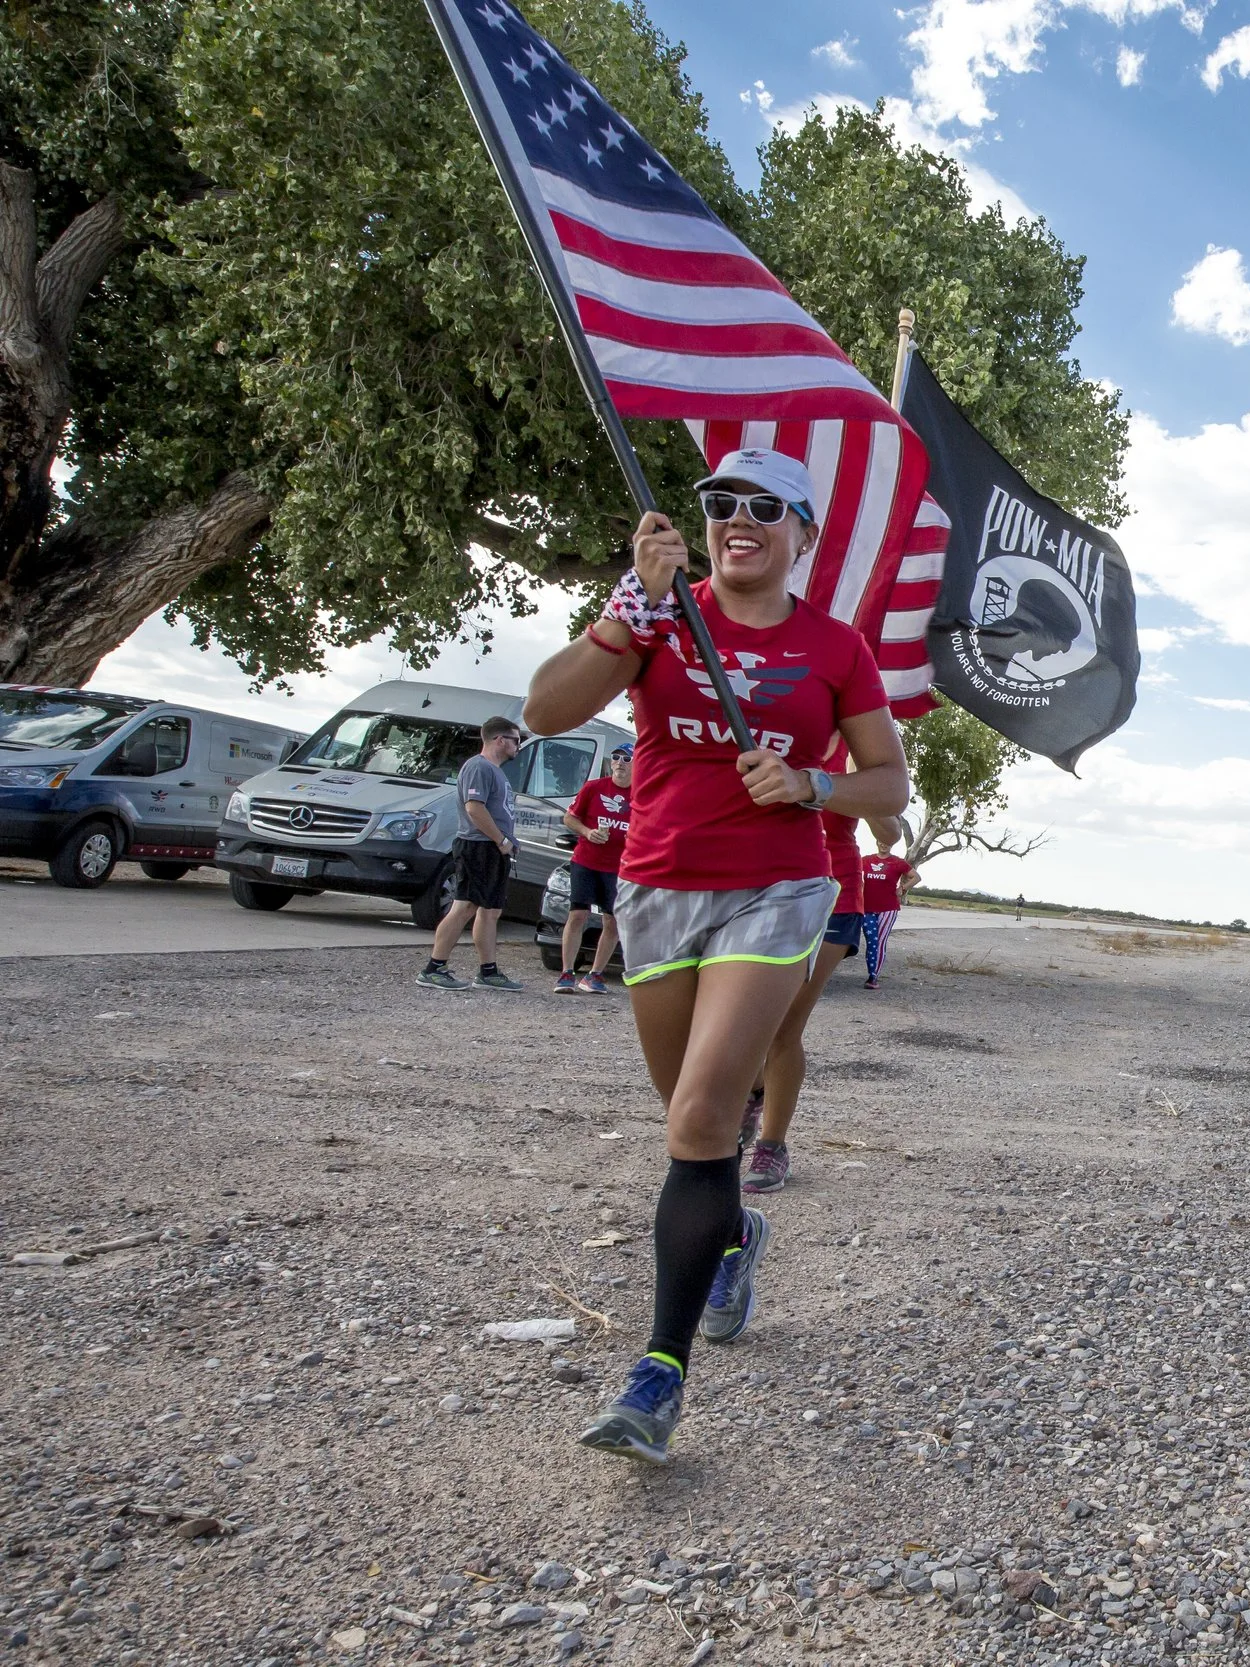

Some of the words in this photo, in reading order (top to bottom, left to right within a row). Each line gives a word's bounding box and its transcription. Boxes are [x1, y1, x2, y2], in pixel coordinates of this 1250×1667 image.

[977, 485, 1048, 564] POW
[1057, 529, 1105, 628] MIA
[950, 630, 964, 651] YOU
[956, 653, 974, 675] ARE
[970, 673, 989, 692] NOT
[986, 688, 1050, 707] FORGOTTEN
[669, 716, 794, 757] RWB
[241, 747, 273, 762] Microsoft
[516, 818, 545, 830] LORY
[520, 811, 535, 819] OLD
